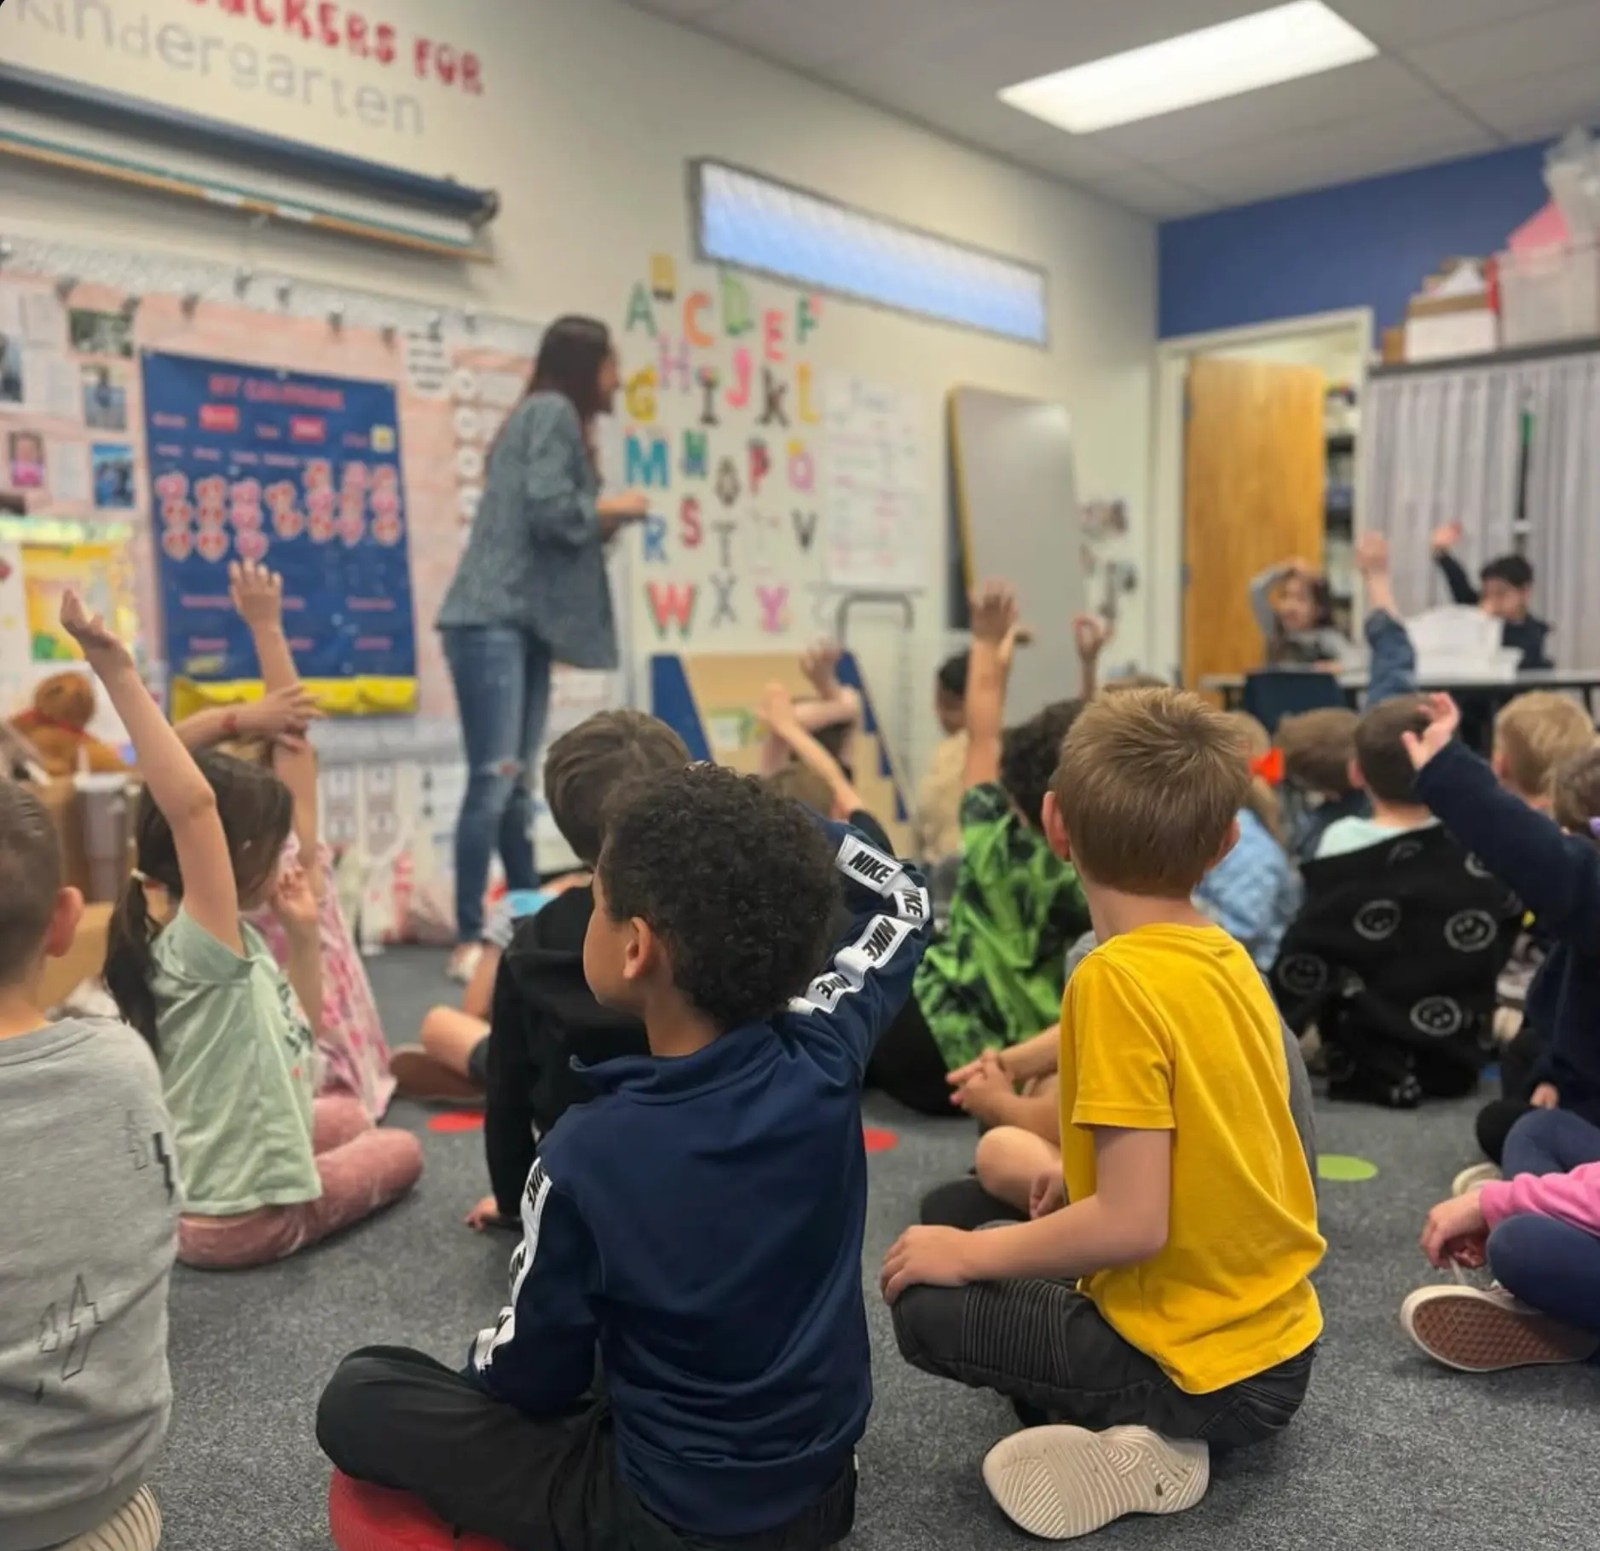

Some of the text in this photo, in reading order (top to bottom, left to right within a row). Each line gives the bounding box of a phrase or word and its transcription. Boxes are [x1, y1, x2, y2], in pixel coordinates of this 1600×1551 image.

[188, 0, 485, 96] CKERS FOR
[625, 281, 657, 338] A
[682, 290, 714, 348] C
[762, 309, 786, 363] E
[625, 366, 658, 423] G
[658, 335, 690, 393] H
[725, 348, 752, 408] J
[755, 365, 790, 428] K
[795, 361, 821, 424] L
[624, 432, 670, 489] M
[747, 437, 771, 496] P
[642, 513, 668, 564] R
[679, 496, 703, 549] S
[711, 519, 737, 569] T
[791, 507, 817, 553] V
[646, 571, 790, 640] W X Y
[847, 849, 895, 885] NIKE
[901, 889, 924, 919] IKE
[861, 917, 898, 962] NIKE
